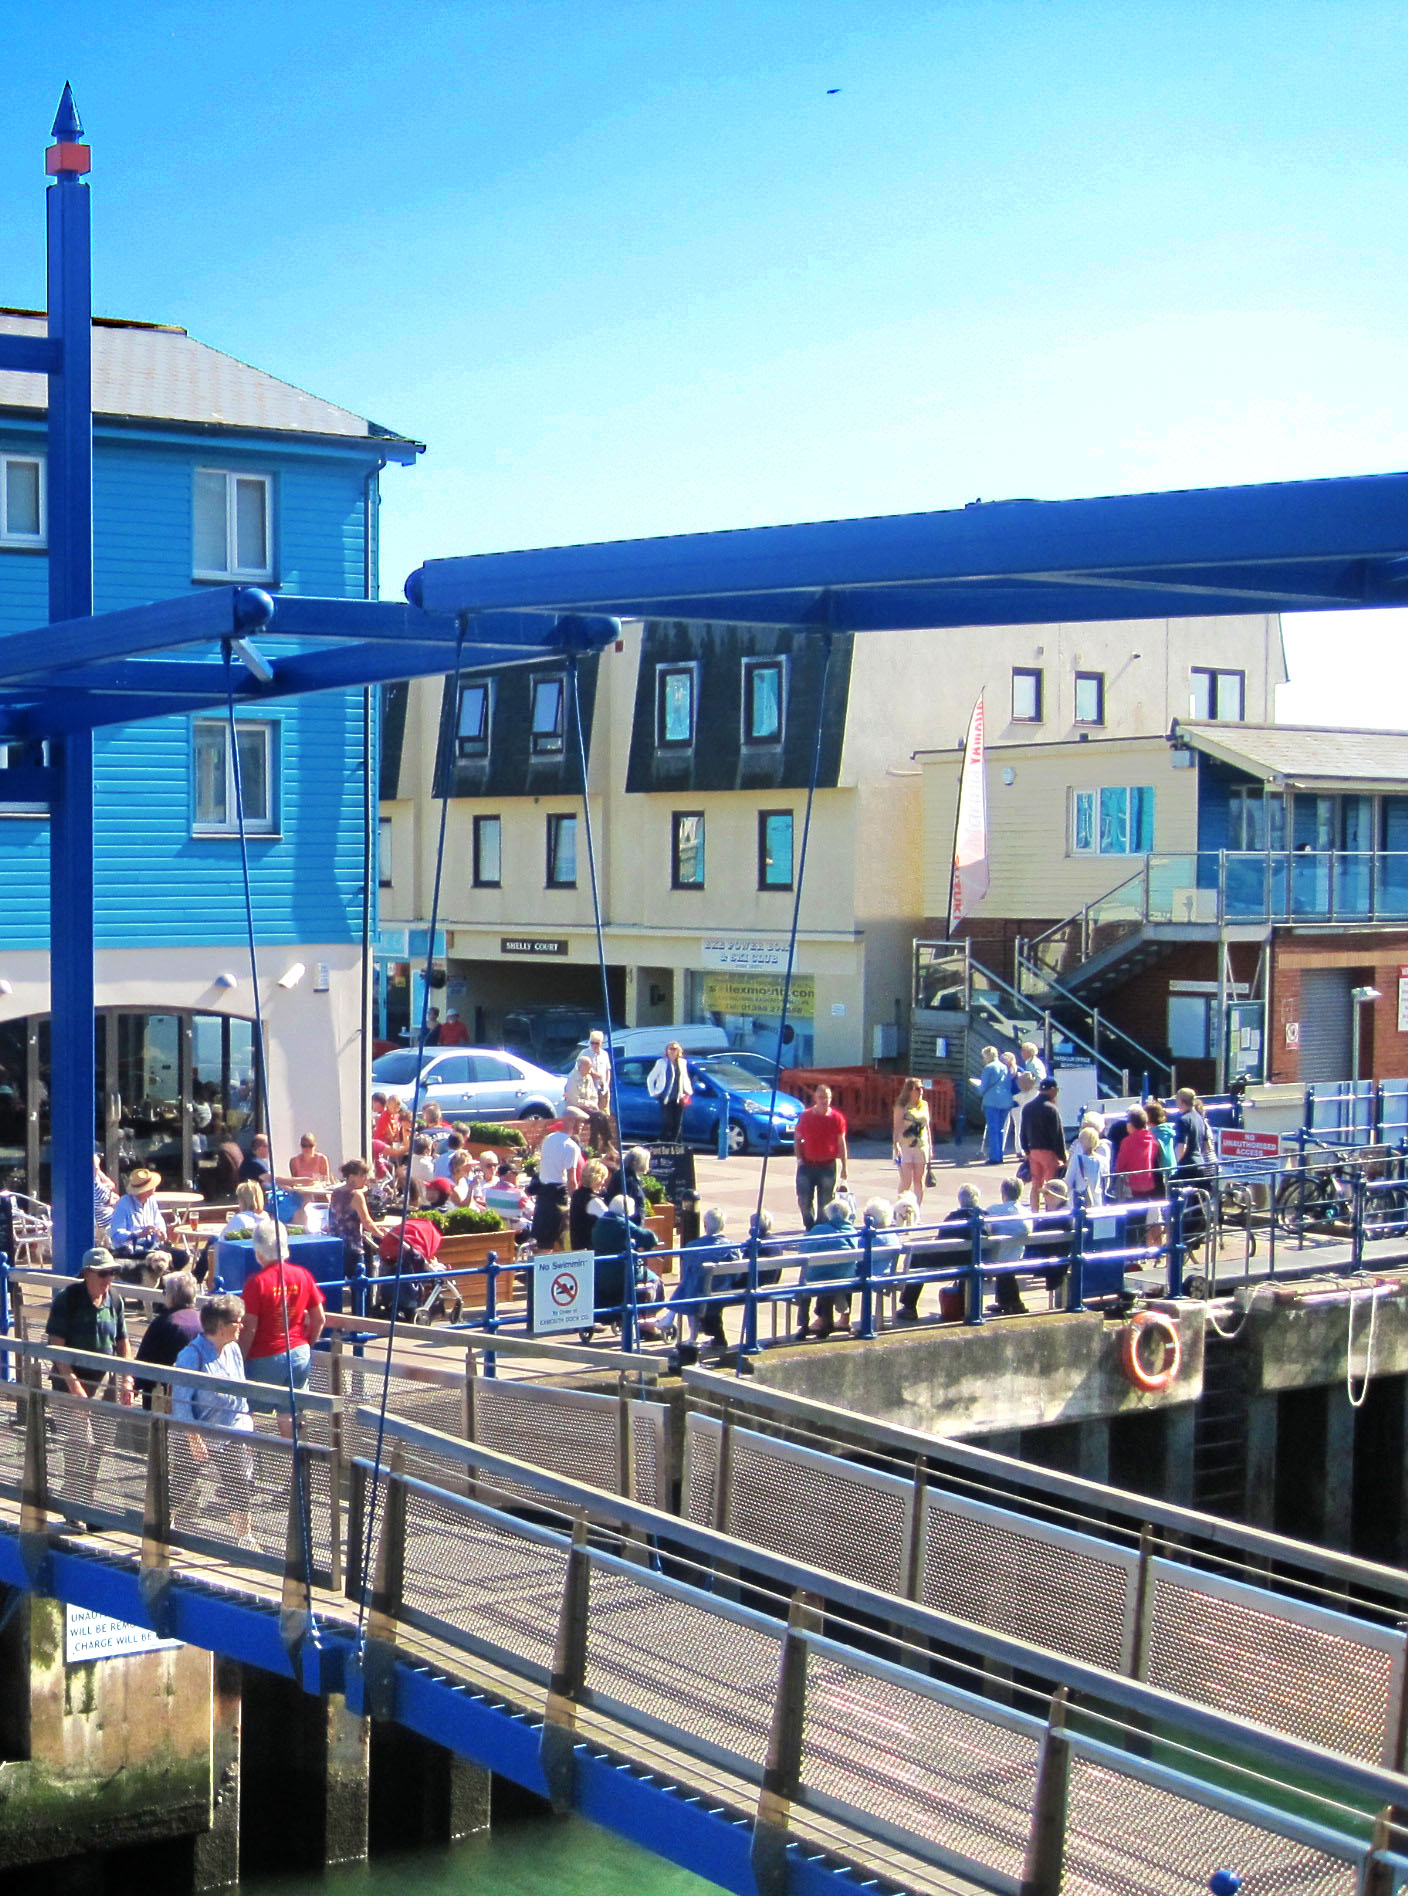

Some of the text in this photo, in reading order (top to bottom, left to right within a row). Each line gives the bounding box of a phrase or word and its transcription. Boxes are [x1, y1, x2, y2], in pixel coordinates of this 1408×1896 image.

[506, 941, 559, 951] SHELLY COURT
[727, 941, 764, 951] POWER
[752, 954, 779, 964] CLUB
[1236, 1148, 1264, 1157] ACCESS
[539, 1263, 550, 1271] No
[70, 1626, 92, 1637] WILL
[95, 1623, 107, 1634] BE
[74, 1632, 152, 1651] CHARGE WILL BE
